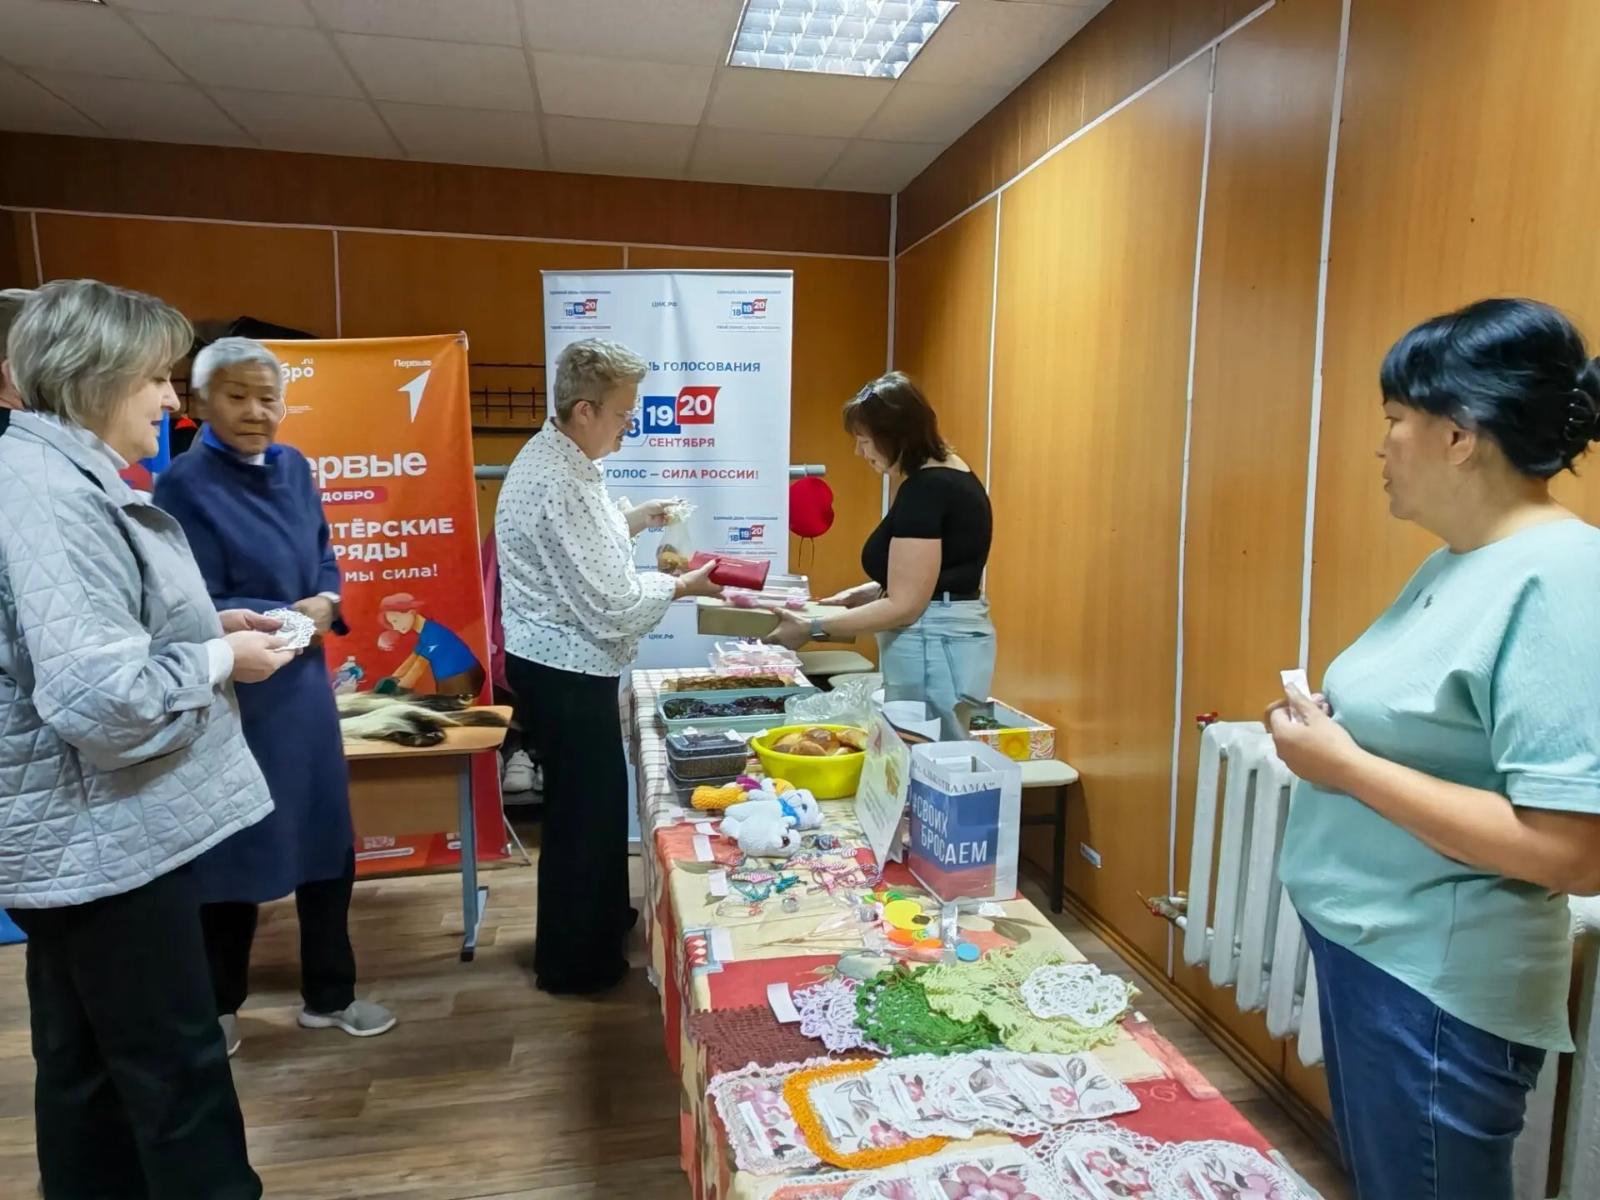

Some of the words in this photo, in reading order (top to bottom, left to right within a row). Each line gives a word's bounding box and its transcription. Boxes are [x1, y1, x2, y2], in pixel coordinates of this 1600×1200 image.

[754, 301, 765, 309] 20
[279, 363, 315, 382] бро
[663, 361, 761, 372] ГОЛОСОВАНИЯ
[646, 404, 674, 427] 19
[679, 395, 713, 417] 20
[649, 437, 716, 448] СЕНТЯБРЯ
[606, 468, 647, 480] ГОЛОС
[662, 468, 698, 480] СИЛА
[701, 468, 759, 480] РОССИИ!
[751, 527, 763, 535] 20
[332, 541, 408, 562] РЯДЫ
[382, 563, 439, 581] сила!
[921, 824, 988, 865] БРОСАЕМ
